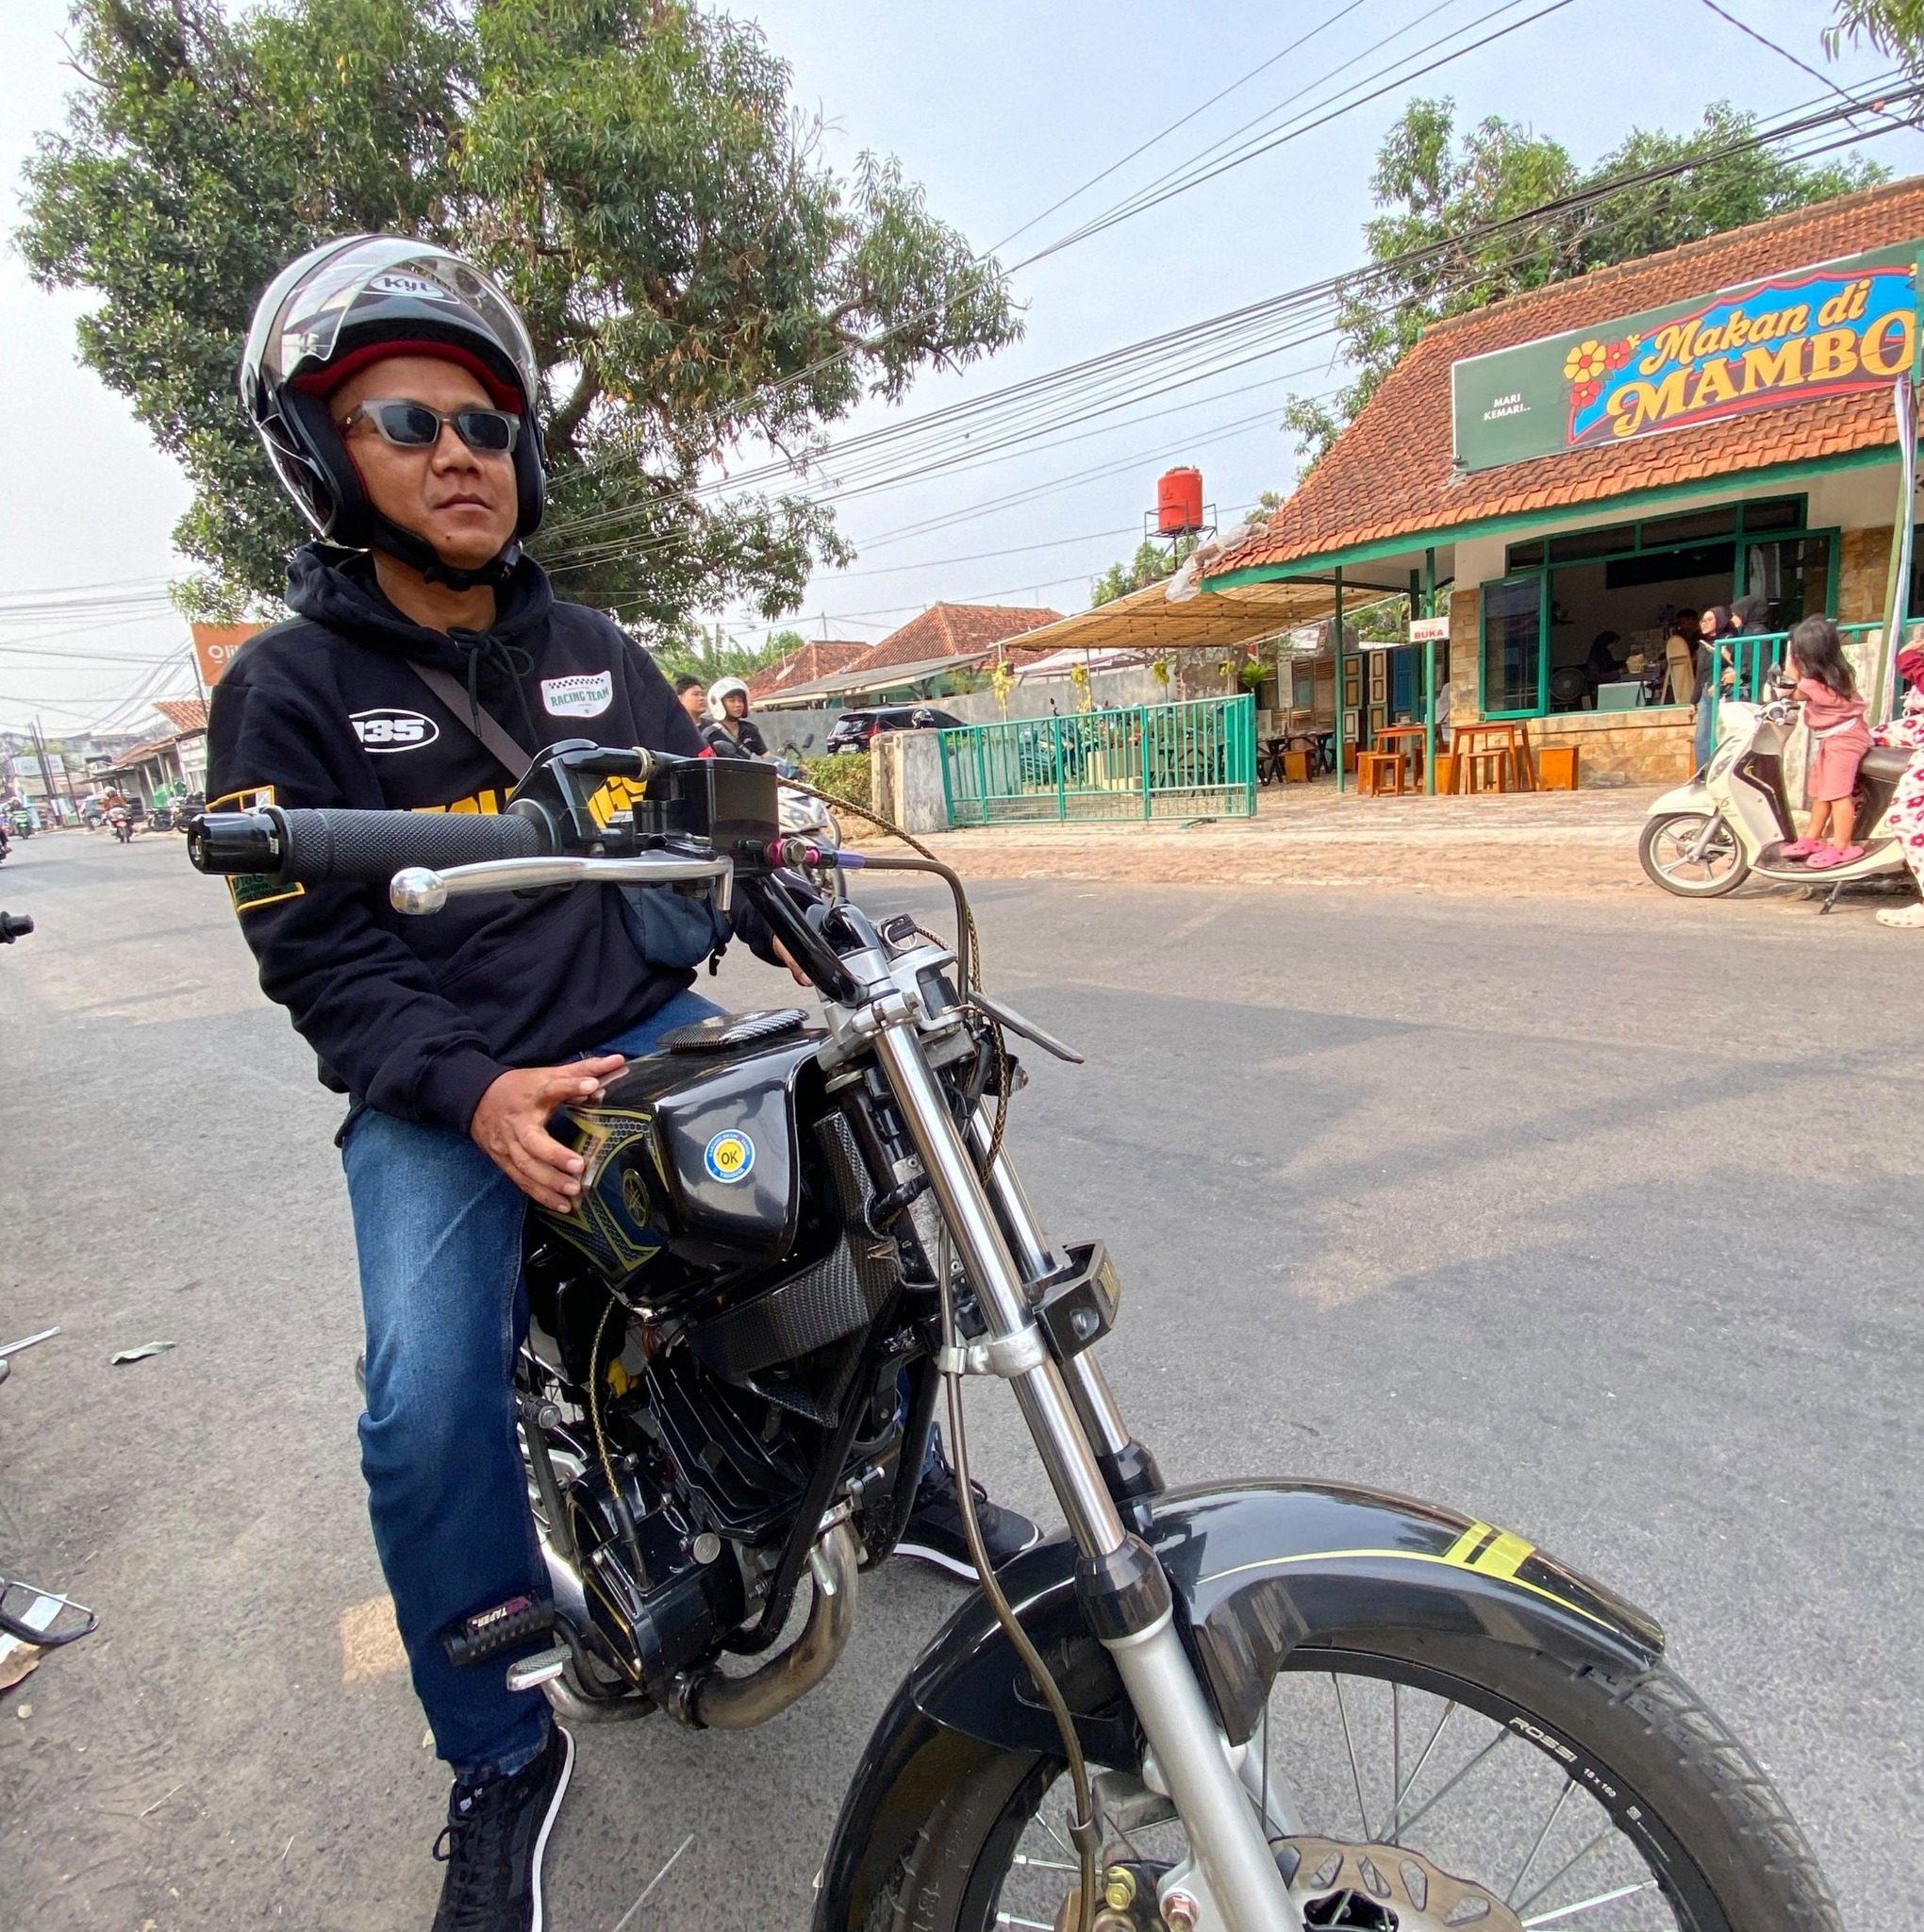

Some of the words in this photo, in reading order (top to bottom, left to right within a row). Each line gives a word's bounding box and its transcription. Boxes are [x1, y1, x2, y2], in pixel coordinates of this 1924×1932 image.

[1639, 304, 1810, 375] Makan
[1818, 279, 1871, 327] di
[1606, 309, 1916, 437] MAMBO
[1494, 392, 1520, 408] MARI
[1415, 629, 1444, 639] BUKA
[550, 691, 586, 707] RACING
[586, 687, 609, 701] TEAM
[721, 1150, 738, 1165] OK
[1508, 1716, 1578, 1762] ROSSI
